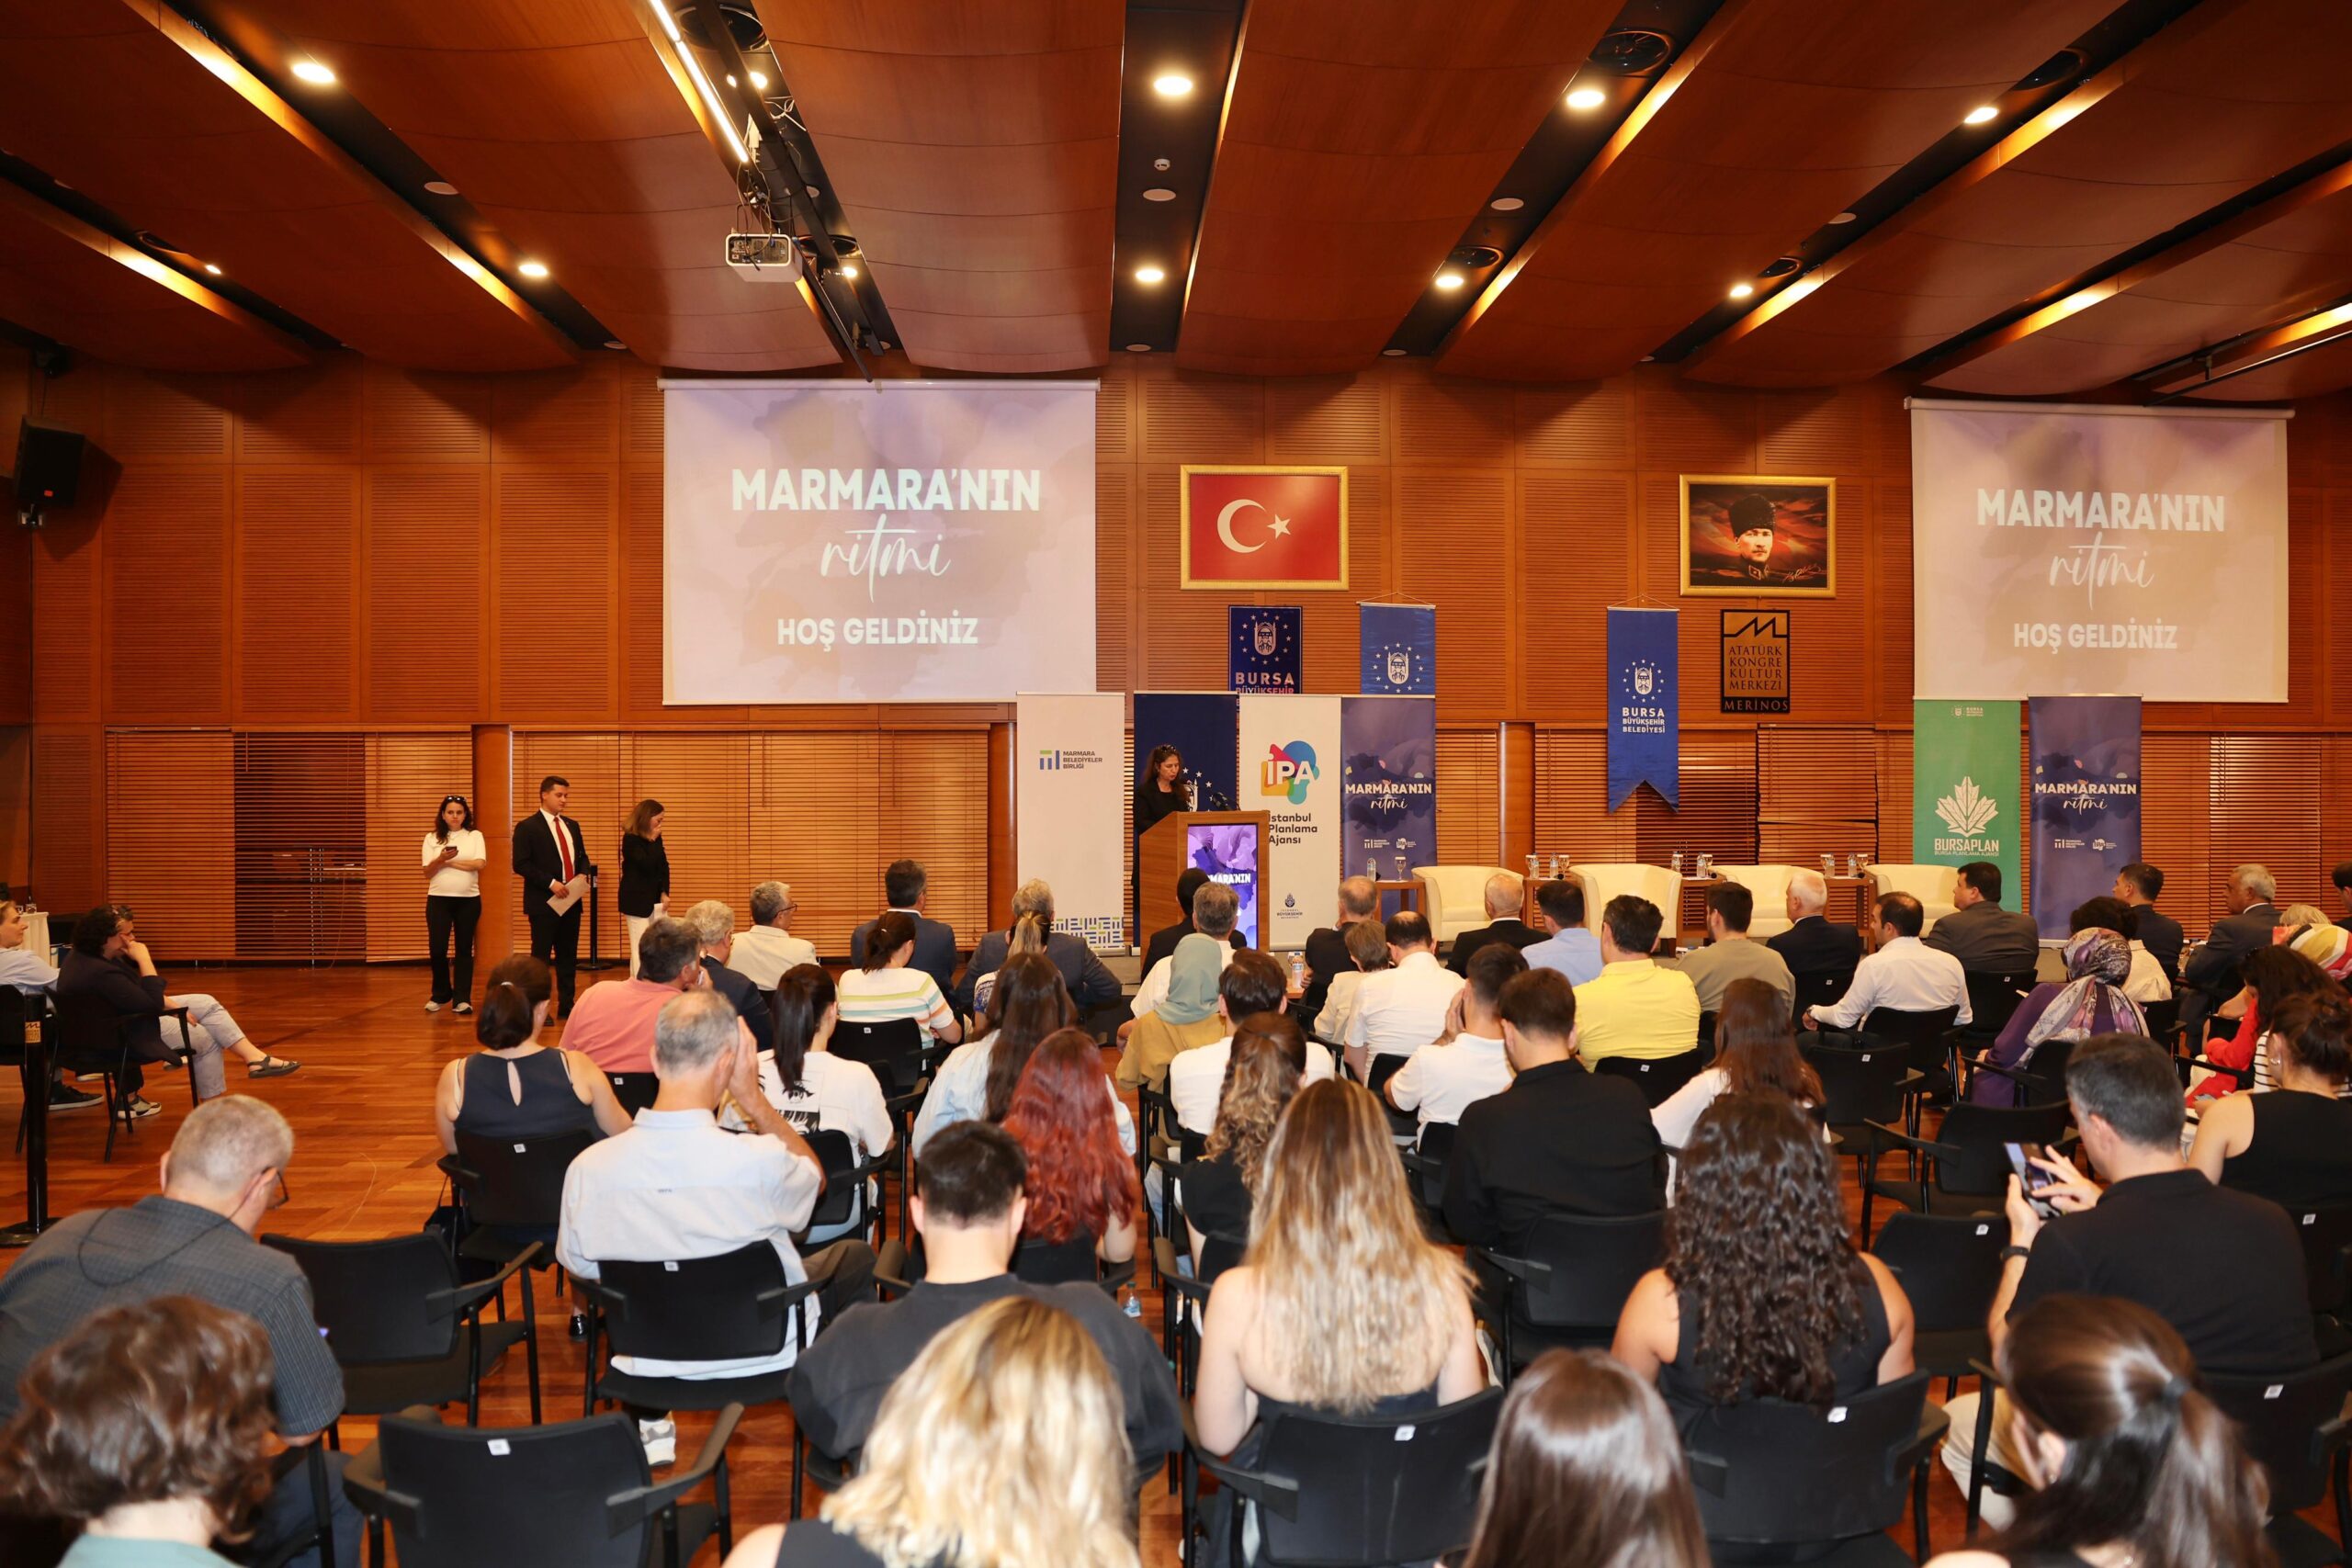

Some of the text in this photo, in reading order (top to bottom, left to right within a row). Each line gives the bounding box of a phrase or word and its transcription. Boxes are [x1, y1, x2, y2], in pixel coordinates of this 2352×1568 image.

[731, 468, 1040, 511] MARMARA'NIN
[1977, 488, 2225, 532] MARMARA'NIN
[820, 513, 951, 603] ritmi
[2049, 532, 2155, 610] ritmi
[777, 609, 978, 652] HOŞ GELDİNİZ
[2013, 616, 2178, 654] HOŞ GELDİNİZ
[1729, 657, 1782, 668] KONGRE
[1235, 671, 1295, 685] BURSA
[1622, 706, 1665, 716] BURSA
[1623, 716, 1665, 726] BÜYÜKŞEHİR
[1623, 725, 1666, 733] BELEDİYESİ
[1345, 784, 1432, 795] MARMARA'NIN
[2034, 783, 2137, 795] MARMARA'NIN
[1370, 794, 1408, 816] ritmi
[2063, 794, 2109, 816] ritmi
[1269, 824, 1317, 833] Planlama
[1269, 835, 1301, 847] Ajansı
[1934, 838, 1999, 852] BURSAPLAN
